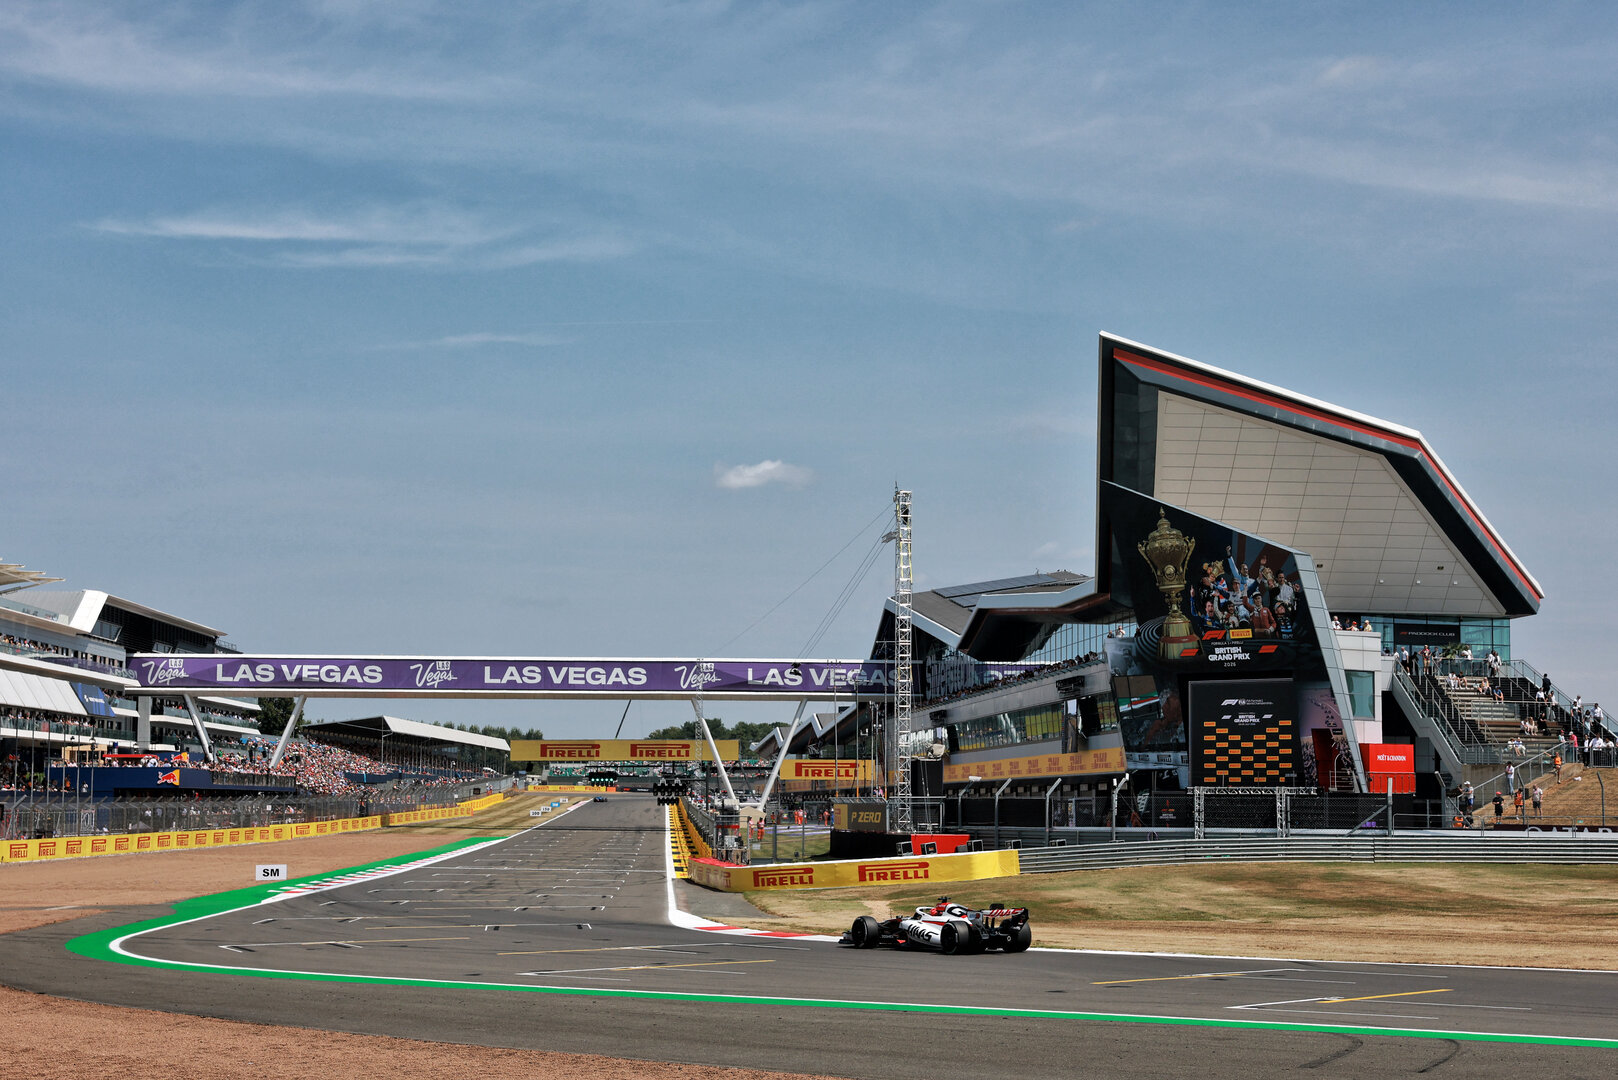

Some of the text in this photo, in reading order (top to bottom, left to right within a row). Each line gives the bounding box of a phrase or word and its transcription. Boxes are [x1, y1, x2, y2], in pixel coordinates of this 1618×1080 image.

[169, 659, 183, 668] LAS
[1208, 653, 1233, 661] GRAND
[142, 660, 189, 685] Vegas
[216, 663, 382, 683] LAS VEGAS
[436, 661, 450, 670] LAS
[410, 662, 458, 688] Vegas
[484, 666, 647, 685] LAS VEGAS
[674, 665, 722, 689] Vegas
[747, 668, 803, 686] LAS
[540, 743, 601, 757] PIRELLI
[630, 743, 691, 757] PIRELLI
[795, 762, 860, 777] PIRELLI
[852, 812, 857, 822] P
[858, 812, 881, 823] ZERO
[10, 843, 28, 858] PIRELLI
[39, 842, 56, 857] PIRELLI
[66, 840, 82, 855] PIRELLI
[91, 839, 107, 853] PIRELLI
[115, 837, 129, 851] PIRELLI
[262, 868, 280, 877] SM
[753, 867, 814, 888] PIRELLI
[858, 861, 929, 882] PIRELLI
[908, 924, 939, 941] HAAS
